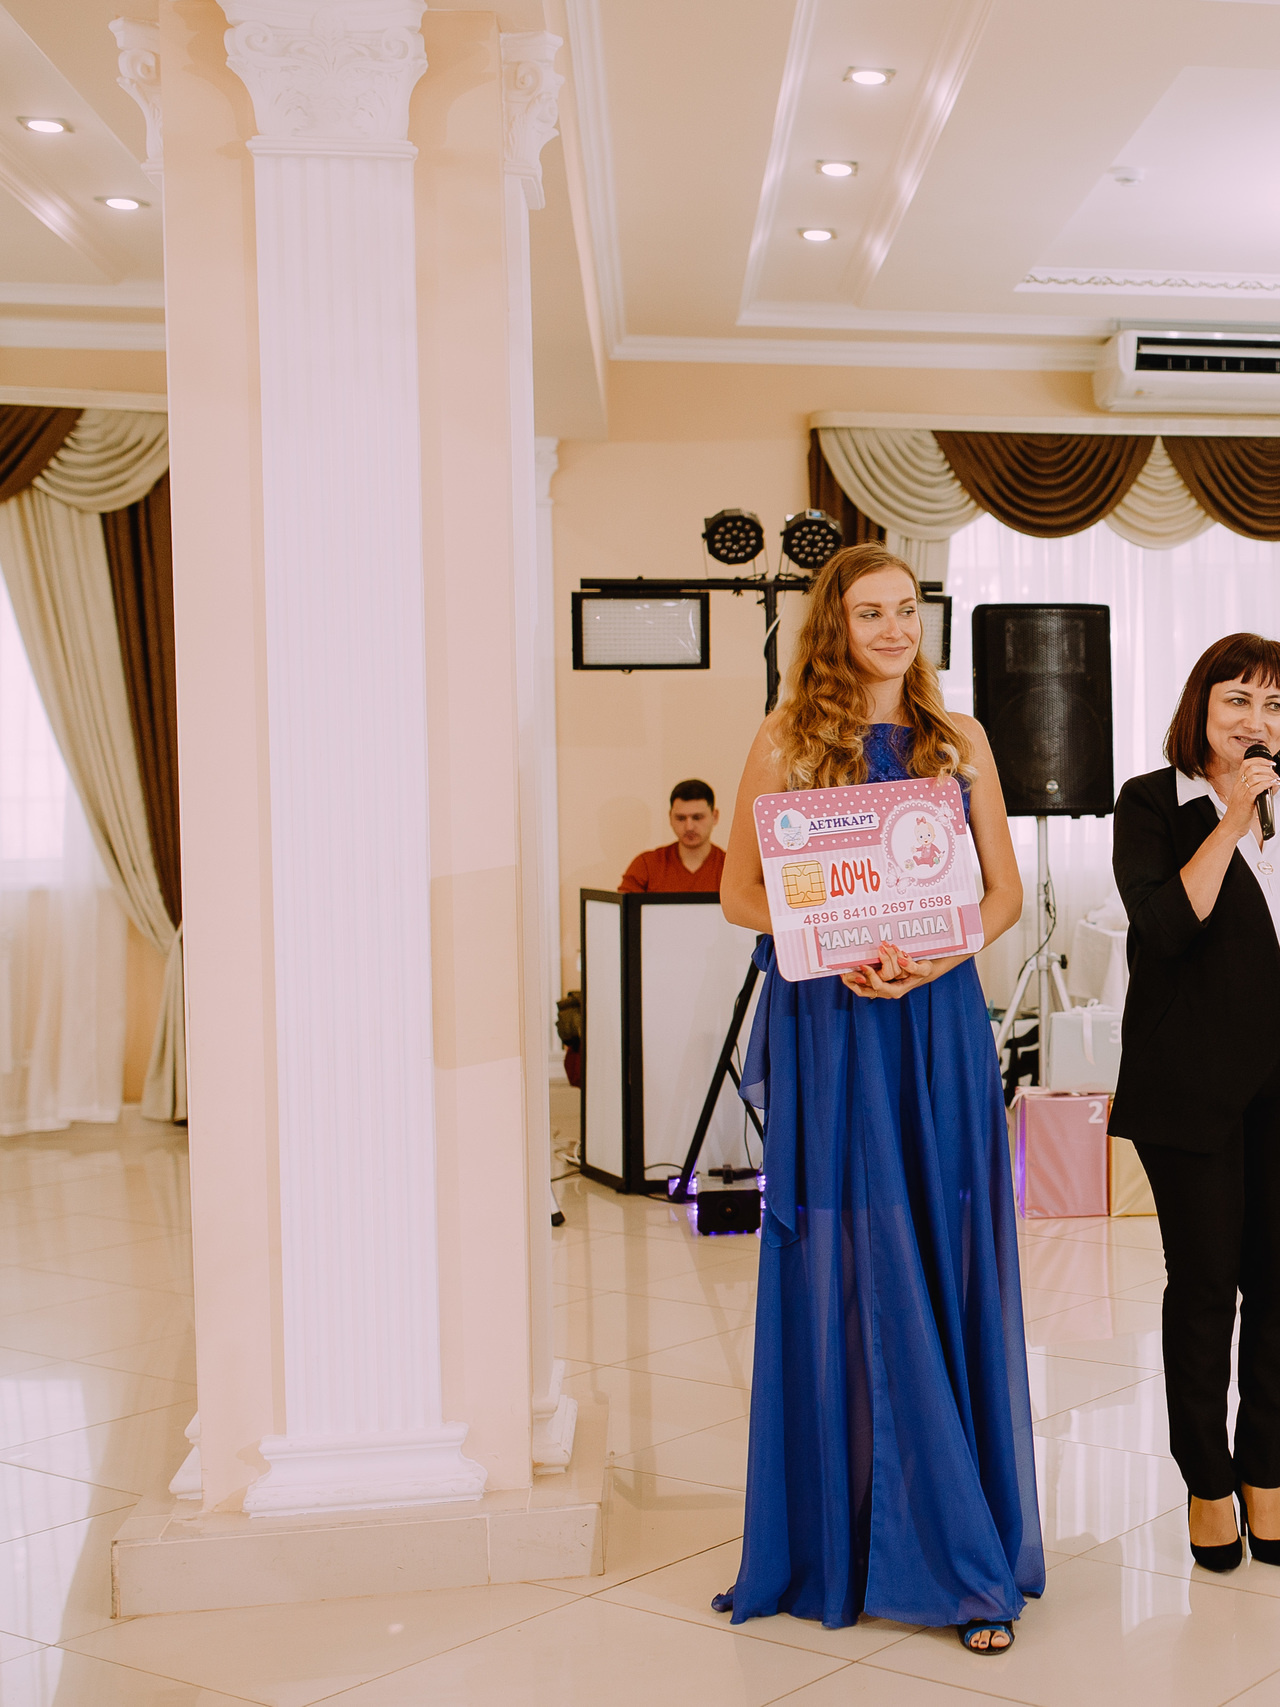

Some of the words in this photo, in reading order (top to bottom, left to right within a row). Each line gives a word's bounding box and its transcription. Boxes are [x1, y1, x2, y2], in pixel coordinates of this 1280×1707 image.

[808, 814, 874, 831] ДЕТИКАРТ
[830, 858, 880, 897] ДОЧЬ
[803, 910, 839, 925] 4896
[843, 905, 877, 920] 8410
[882, 900, 914, 914] 2697
[920, 894, 952, 909] 6598
[818, 926, 873, 950] МАМА
[879, 923, 892, 941] И
[898, 915, 949, 939] ПАПА
[1109, 1021, 1121, 1043] 3
[1088, 1101, 1104, 1124] 2
